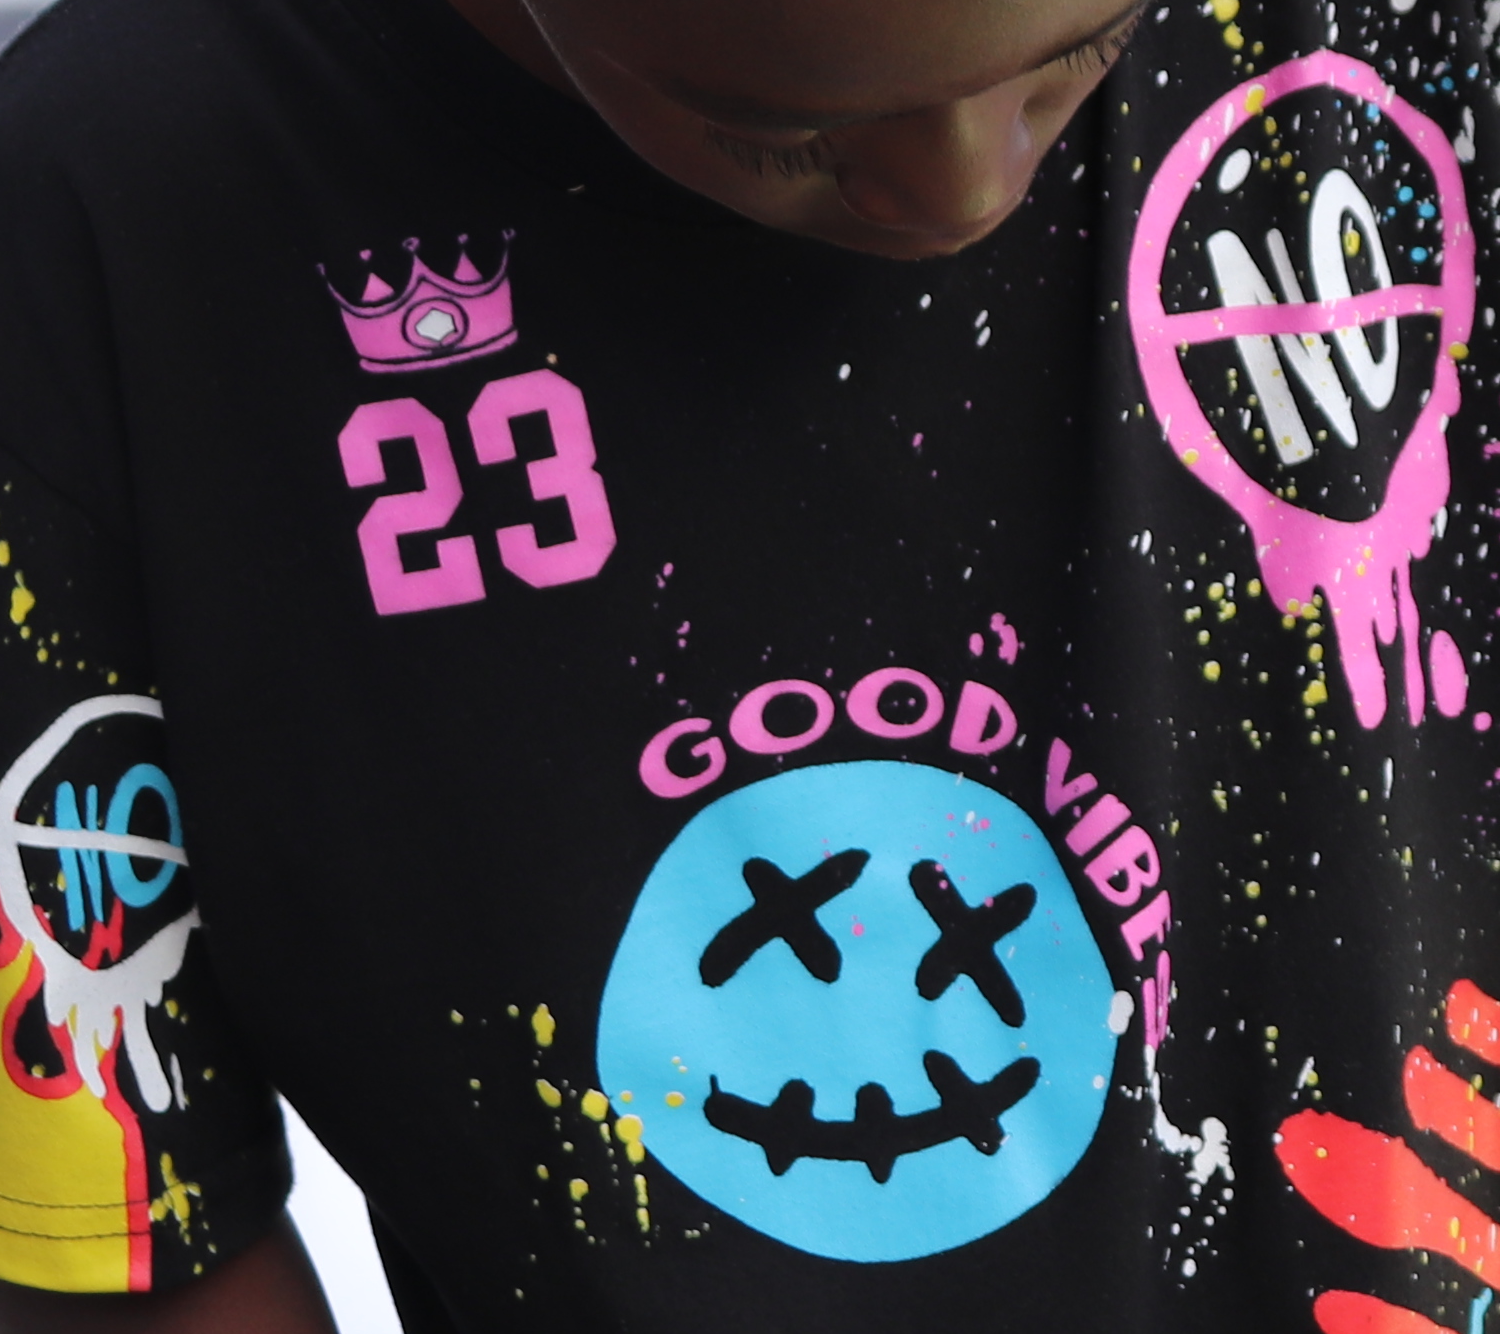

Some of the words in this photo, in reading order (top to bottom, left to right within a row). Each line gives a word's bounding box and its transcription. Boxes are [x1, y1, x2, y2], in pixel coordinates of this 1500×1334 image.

[1206, 167, 1399, 465] NO
[337, 369, 617, 615] 23
[638, 666, 1018, 798] GOOD
[55, 763, 184, 932] NO
